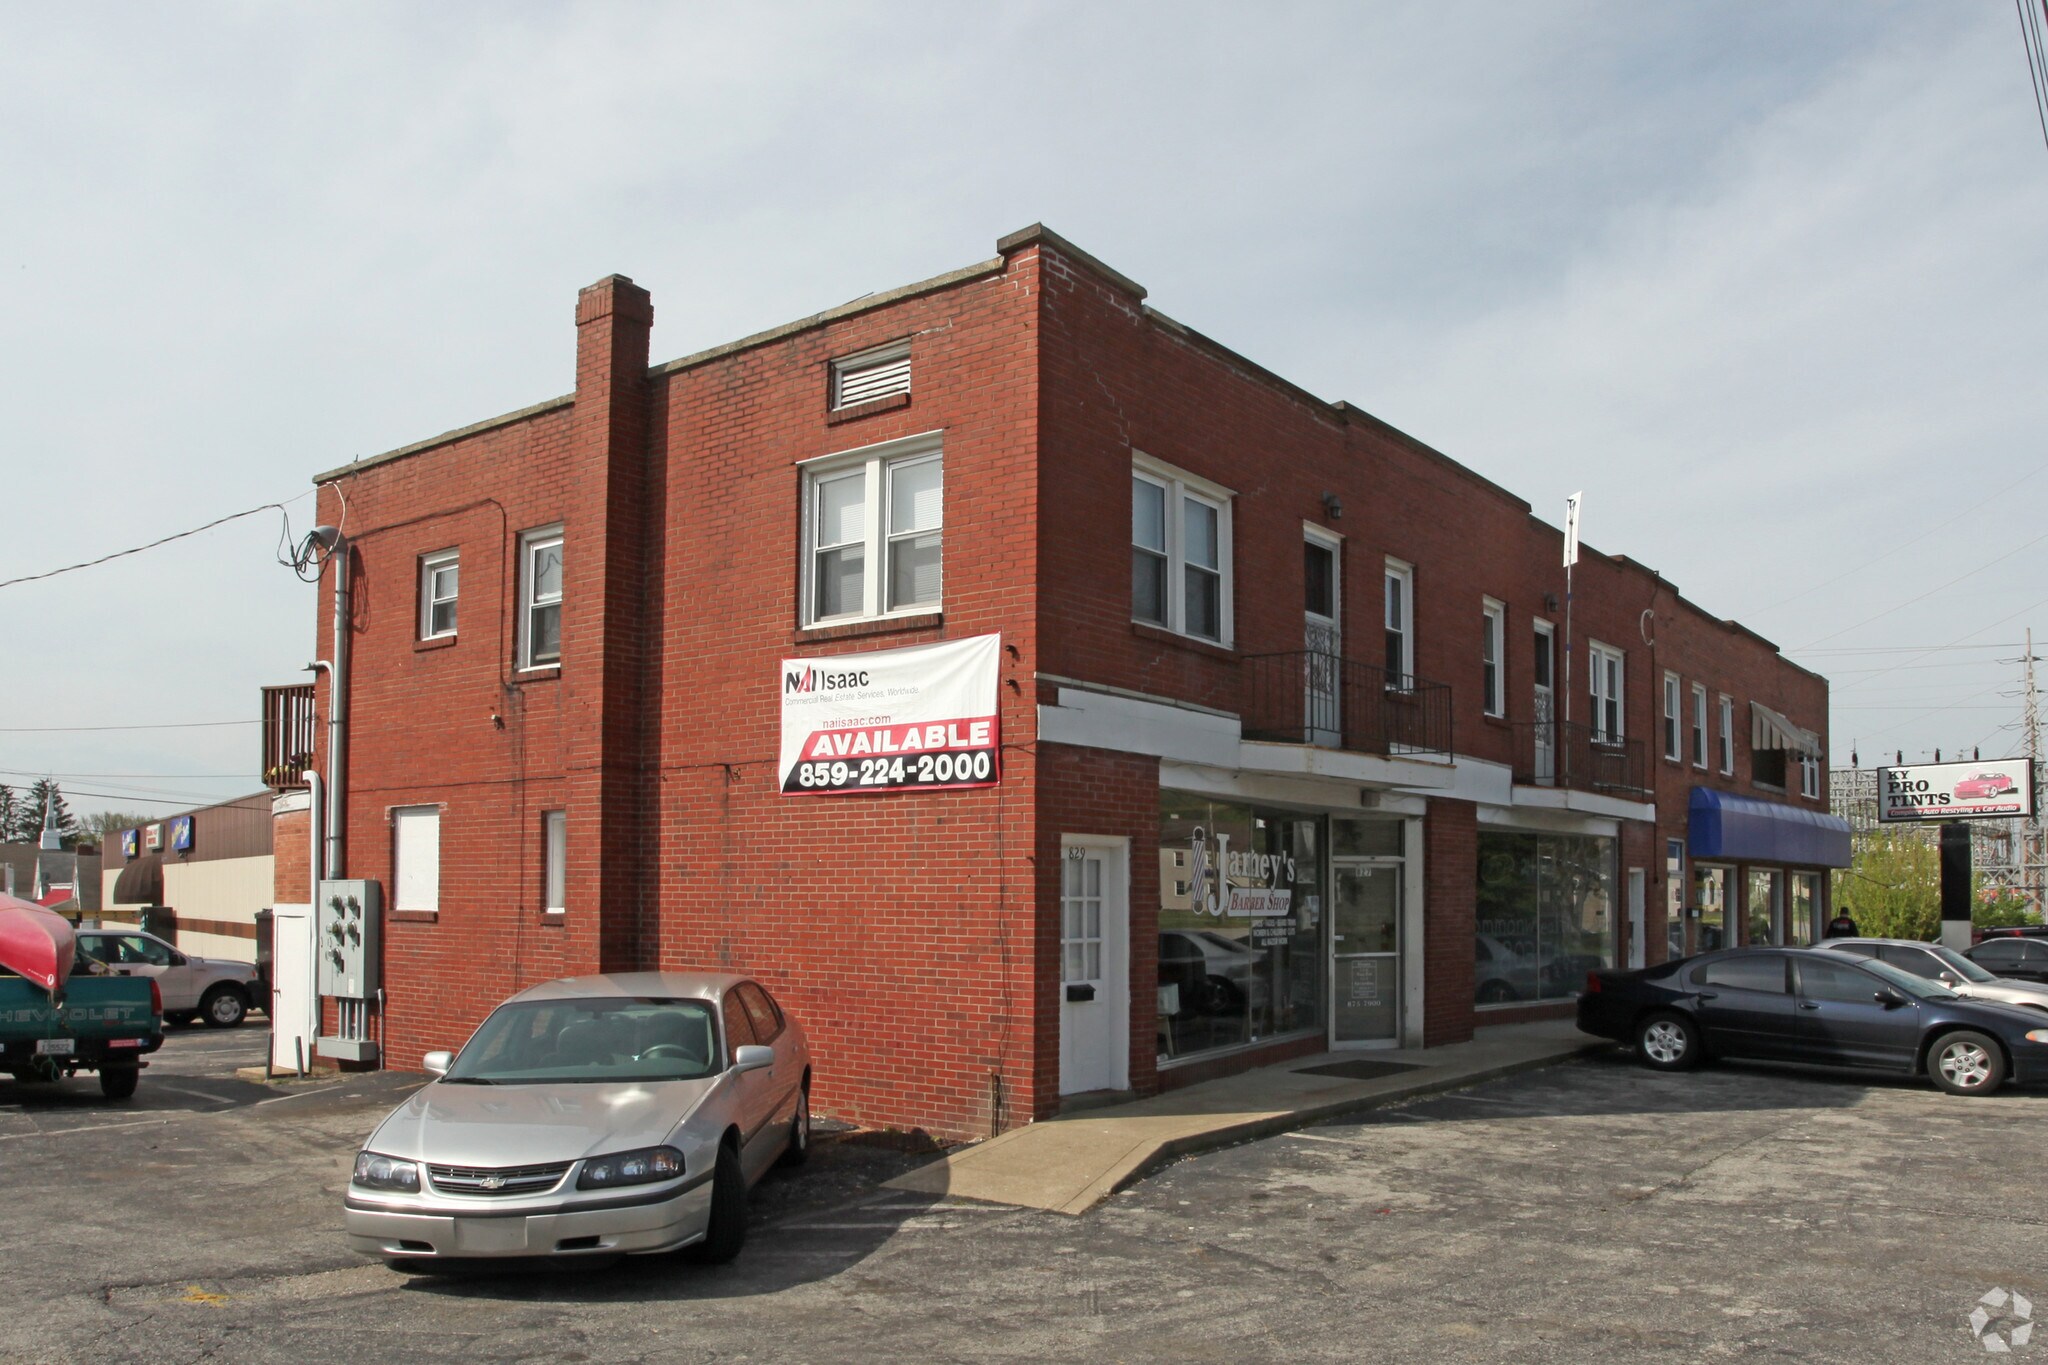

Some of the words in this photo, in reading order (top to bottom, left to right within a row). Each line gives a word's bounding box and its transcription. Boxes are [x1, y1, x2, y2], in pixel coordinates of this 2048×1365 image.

[786, 664, 817, 694] NAI
[821, 670, 870, 691] Isaac
[785, 695, 820, 706] Commercial
[820, 693, 833, 703] Real
[834, 691, 855, 702] Estate
[822, 714, 891, 729] naiisaac.com
[810, 721, 991, 757] AVAILABLE
[799, 751, 991, 788] 859-224-2000
[1887, 770, 1910, 781] KY
[1887, 780, 1930, 794] PRO
[1888, 793, 1951, 807] TINTS
[1922, 808, 1940, 816] Auto
[1940, 806, 1974, 815] Restyling
[1995, 804, 2018, 812] Audio
[1068, 846, 1086, 860] 829
